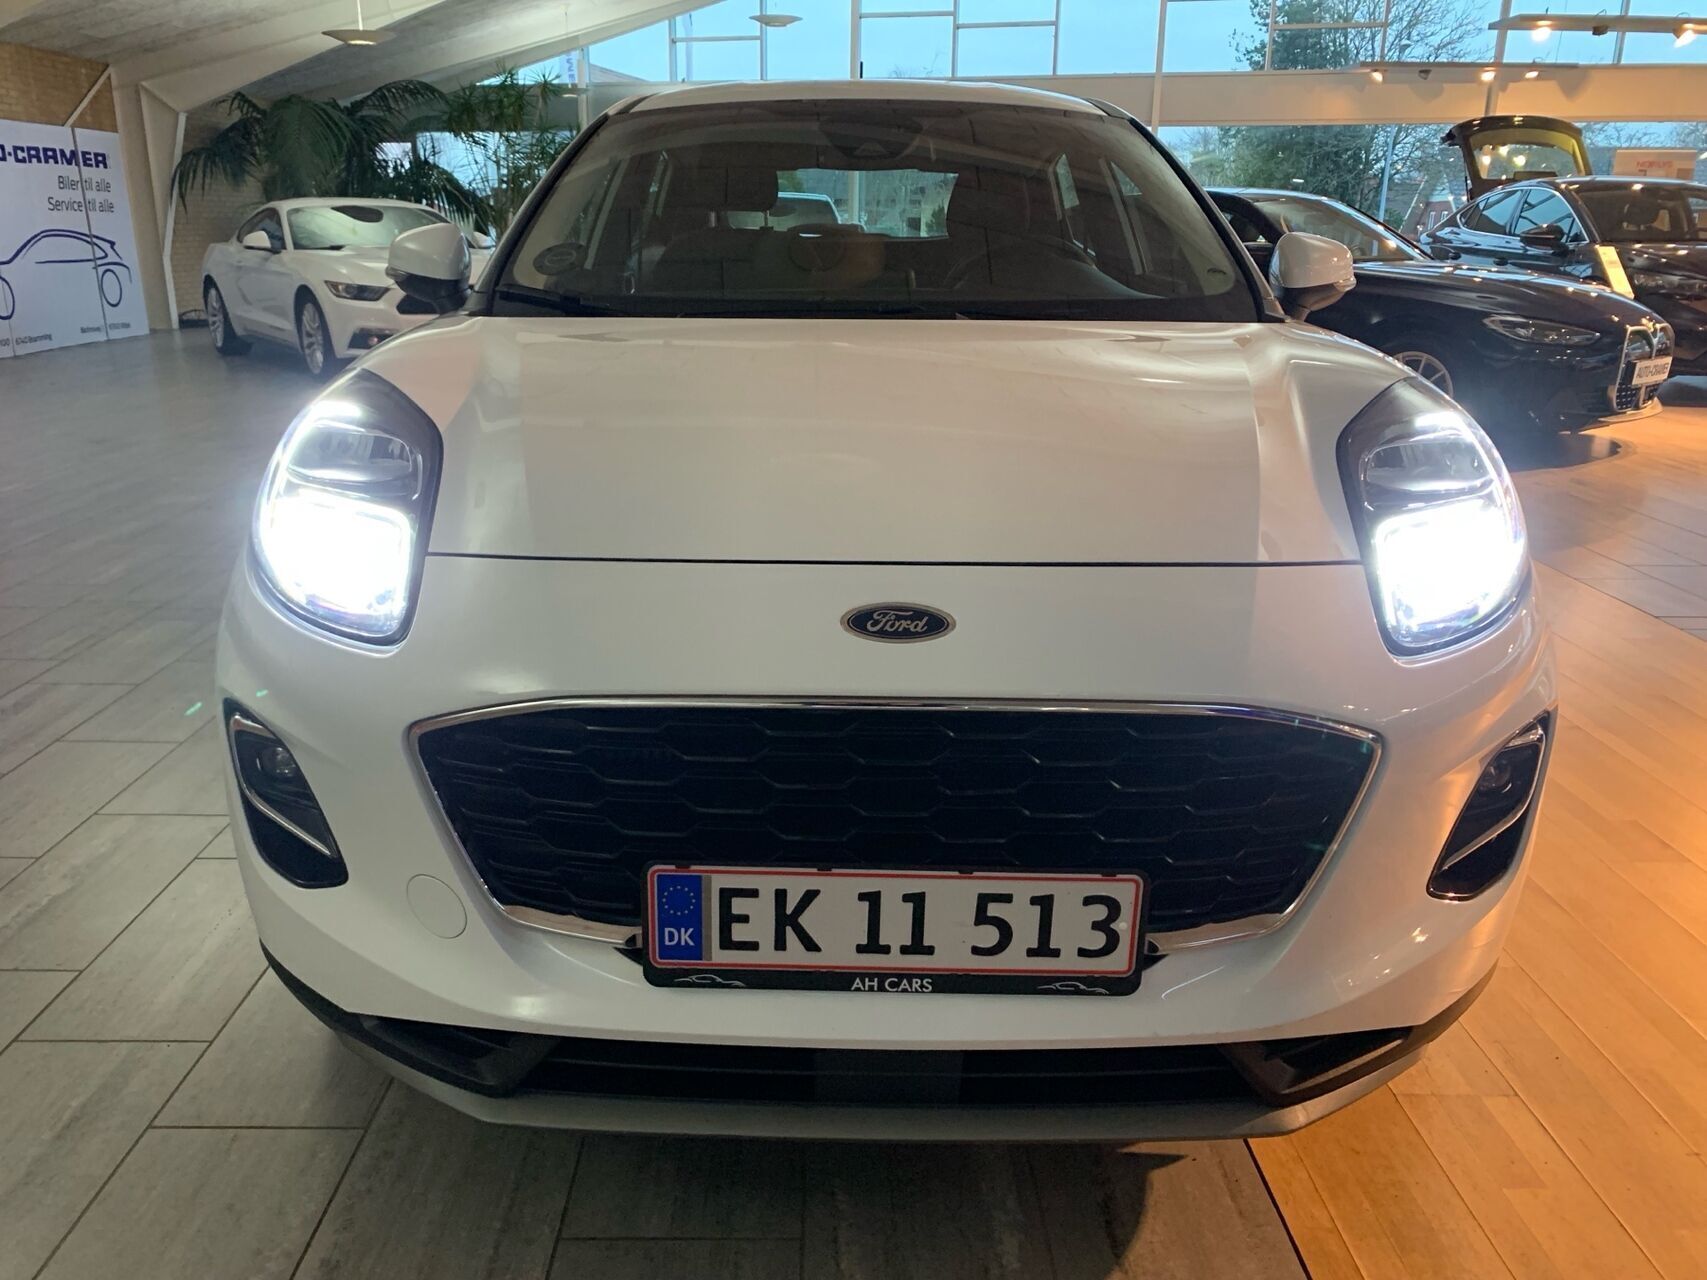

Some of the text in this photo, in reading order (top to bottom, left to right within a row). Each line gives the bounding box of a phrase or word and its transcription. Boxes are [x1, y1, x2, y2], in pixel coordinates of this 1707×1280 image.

[58, 175, 111, 193] Biler til alle
[47, 196, 115, 213] Service til alle
[866, 609, 928, 632] Ford
[718, 887, 1123, 959] EK 11 513
[664, 926, 696, 947] DK
[850, 977, 933, 994] AH CARS
